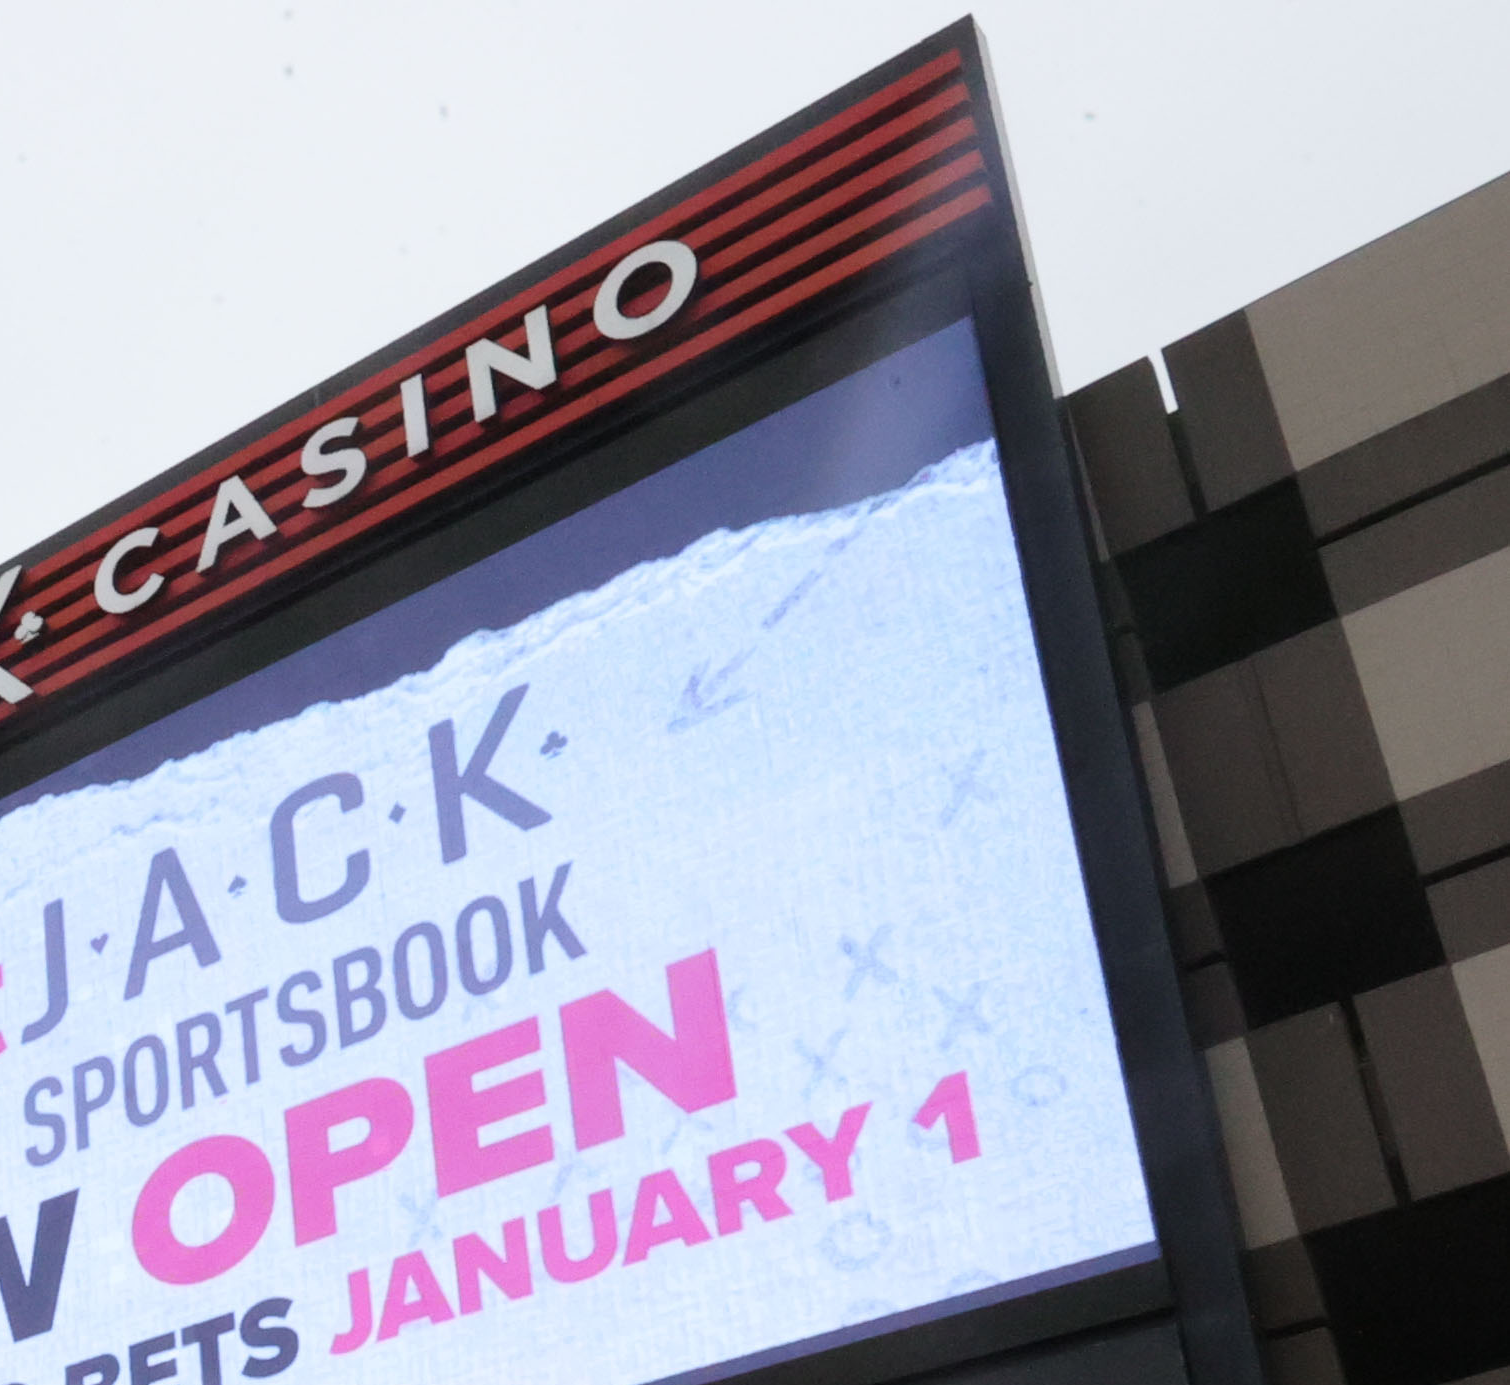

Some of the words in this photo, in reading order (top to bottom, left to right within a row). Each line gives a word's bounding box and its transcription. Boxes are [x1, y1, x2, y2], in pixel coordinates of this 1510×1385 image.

[92, 239, 699, 617] CASINO
[24, 862, 588, 1167] SPORTSBOOK
[131, 947, 738, 1286] OPEN
[329, 1101, 874, 1357] JANUARY
[913, 1070, 982, 1164] 1
